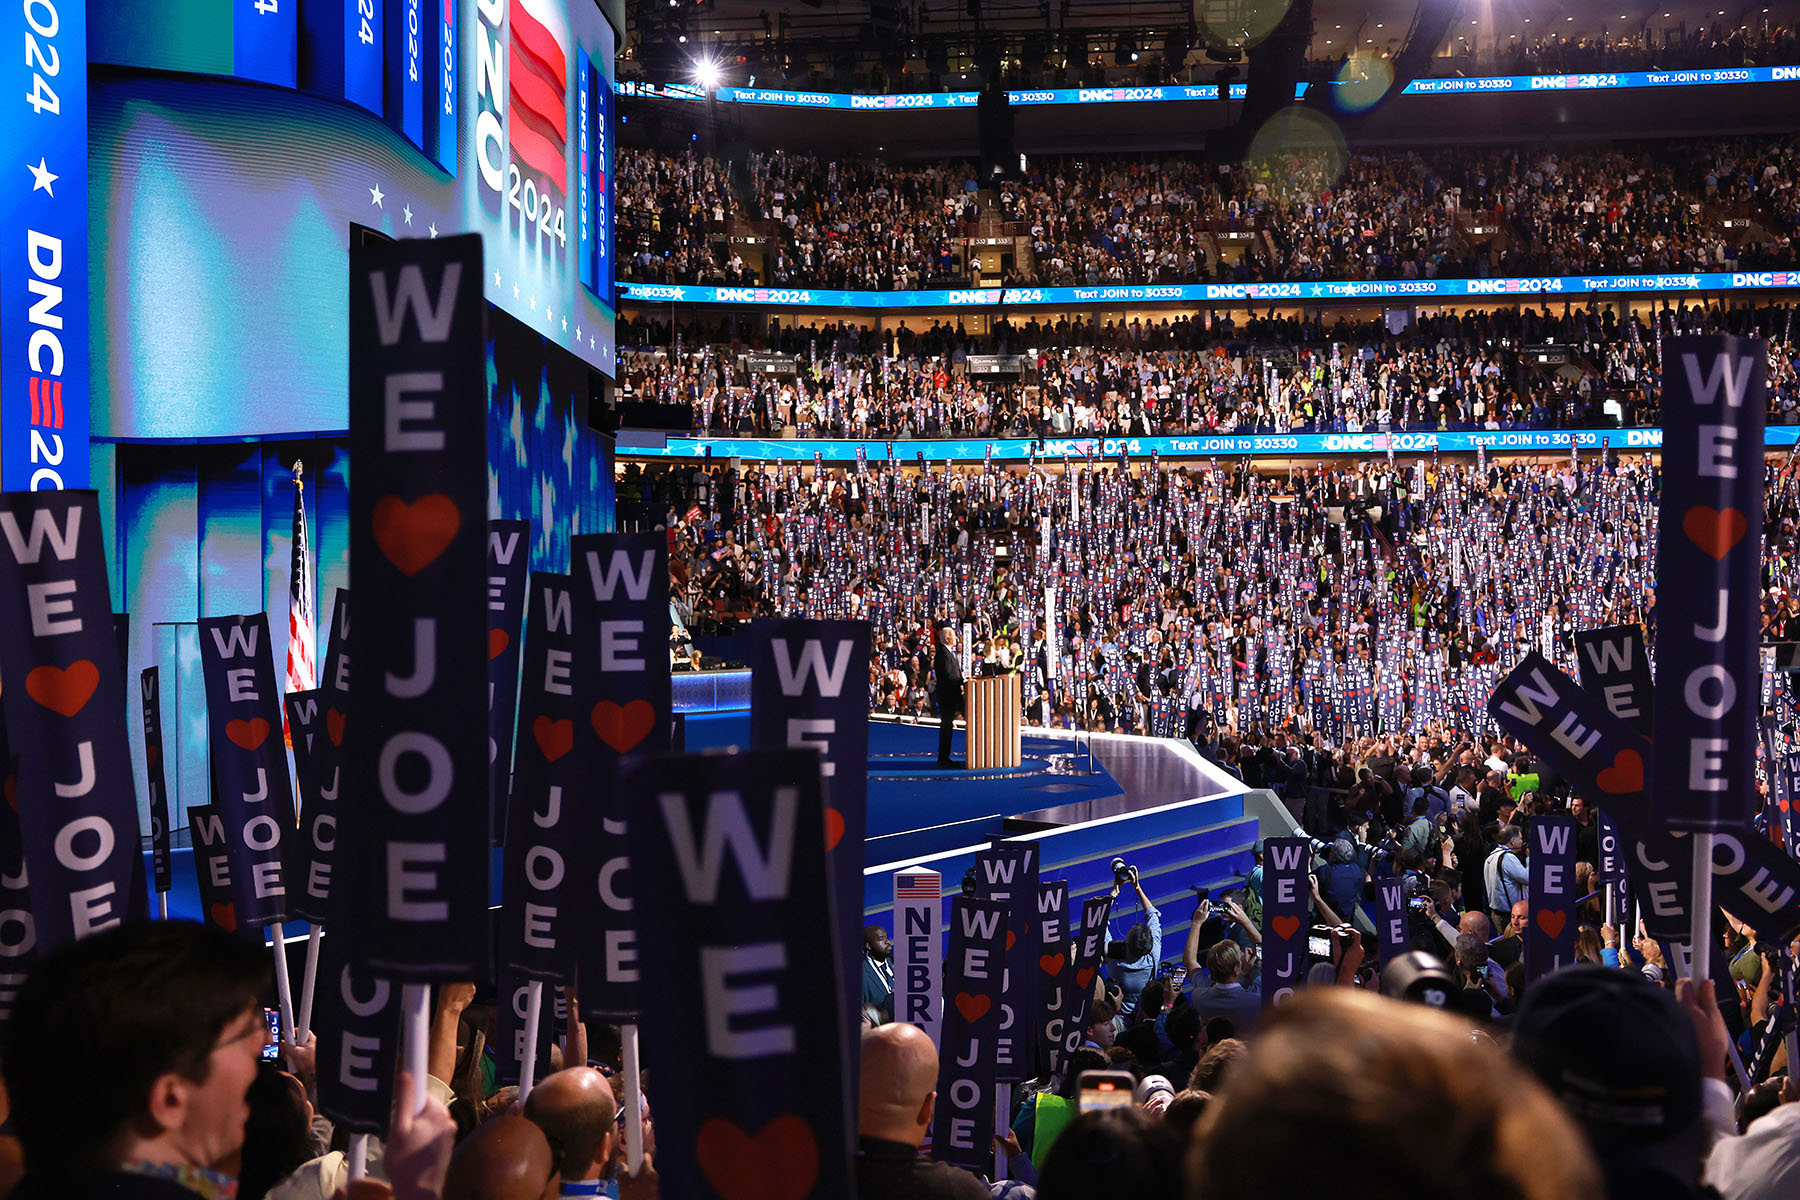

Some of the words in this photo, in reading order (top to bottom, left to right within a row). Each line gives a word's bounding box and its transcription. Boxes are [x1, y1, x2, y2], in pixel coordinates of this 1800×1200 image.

[444, 23, 453, 115] 2024
[733, 89, 756, 100] Text
[757, 91, 783, 101] JOIN
[784, 92, 796, 102] to
[796, 93, 831, 105] 30330
[1009, 93, 1020, 102] to
[1021, 92, 1055, 102] 30330
[1079, 89, 1114, 102] DNC
[1125, 88, 1163, 101] 2024
[1184, 88, 1207, 97] Text
[1235, 87, 1247, 96] to
[1413, 81, 1436, 91] Text
[1437, 80, 1464, 90] JOIN
[1465, 79, 1477, 90] to
[1478, 78, 1512, 89] 30330
[1531, 75, 1566, 89] DNC
[1647, 73, 1669, 83] Text
[1671, 72, 1698, 82] JOIN
[1700, 71, 1712, 81] to
[1714, 70, 1749, 81] 30330
[580, 89, 588, 154] DNC
[851, 95, 885, 108] DNC
[896, 94, 934, 107] 2024
[957, 94, 979, 104] Text
[598, 112, 606, 174] DNC
[509, 163, 567, 248] 2024
[27, 229, 64, 377] DNC
[630, 286, 641, 296] to
[716, 288, 755, 302] DNC
[768, 289, 811, 303] 2024
[949, 290, 986, 304] DNC
[1073, 289, 1098, 299] Text
[1100, 288, 1129, 298] JOIN
[1131, 288, 1143, 298] to
[1145, 287, 1183, 298] 30330
[1207, 285, 1245, 298] DNC
[1258, 283, 1302, 297] 2024
[1384, 283, 1396, 293] to
[1399, 282, 1437, 293] 30330
[1467, 280, 1506, 293] DNC
[1520, 278, 1563, 292] 2024
[1583, 278, 1607, 289] Text
[1610, 277, 1640, 288] JOIN
[1642, 277, 1654, 287] to
[1732, 273, 1773, 287] DNC
[369, 262, 463, 452] WE
[1170, 440, 1199, 450] Text
[1201, 439, 1237, 450] JOIN
[1238, 439, 1251, 449] to
[1253, 438, 1298, 449] 30330
[1326, 435, 1373, 450] DNC
[1391, 434, 1438, 449] 2024
[1467, 435, 1496, 445] Text
[1498, 434, 1532, 445] JOIN
[1535, 433, 1549, 445] to
[1682, 353, 1754, 478] WE
[586, 549, 656, 672] WE
[1585, 636, 1641, 719] WE
[1684, 588, 1738, 792] JOE
[1763, 681, 1771, 704] JOE
[1765, 656, 1777, 672] WE
[1773, 672, 1783, 688] WE
[0, 506, 83, 637] WE
[54, 740, 121, 941] JOE
[770, 638, 854, 777] WE
[1500, 667, 1603, 760] WE
[1776, 698, 1784, 721] JOE
[1782, 690, 1797, 705] WE
[209, 625, 260, 703] WE
[242, 768, 287, 899] JOE
[377, 618, 454, 921] JOE
[195, 813, 232, 887] WE
[306, 766, 340, 899] JOE
[1537, 825, 1570, 895] WE
[525, 786, 566, 950] JOE
[1271, 845, 1303, 903] WE
[659, 786, 801, 1061] WE
[960, 907, 1001, 979] WE
[1037, 887, 1064, 944] WE
[1083, 902, 1108, 959] WE
[1382, 886, 1405, 945] WE
[904, 906, 934, 1031] NEBR
[950, 1038, 982, 1150] JOE
